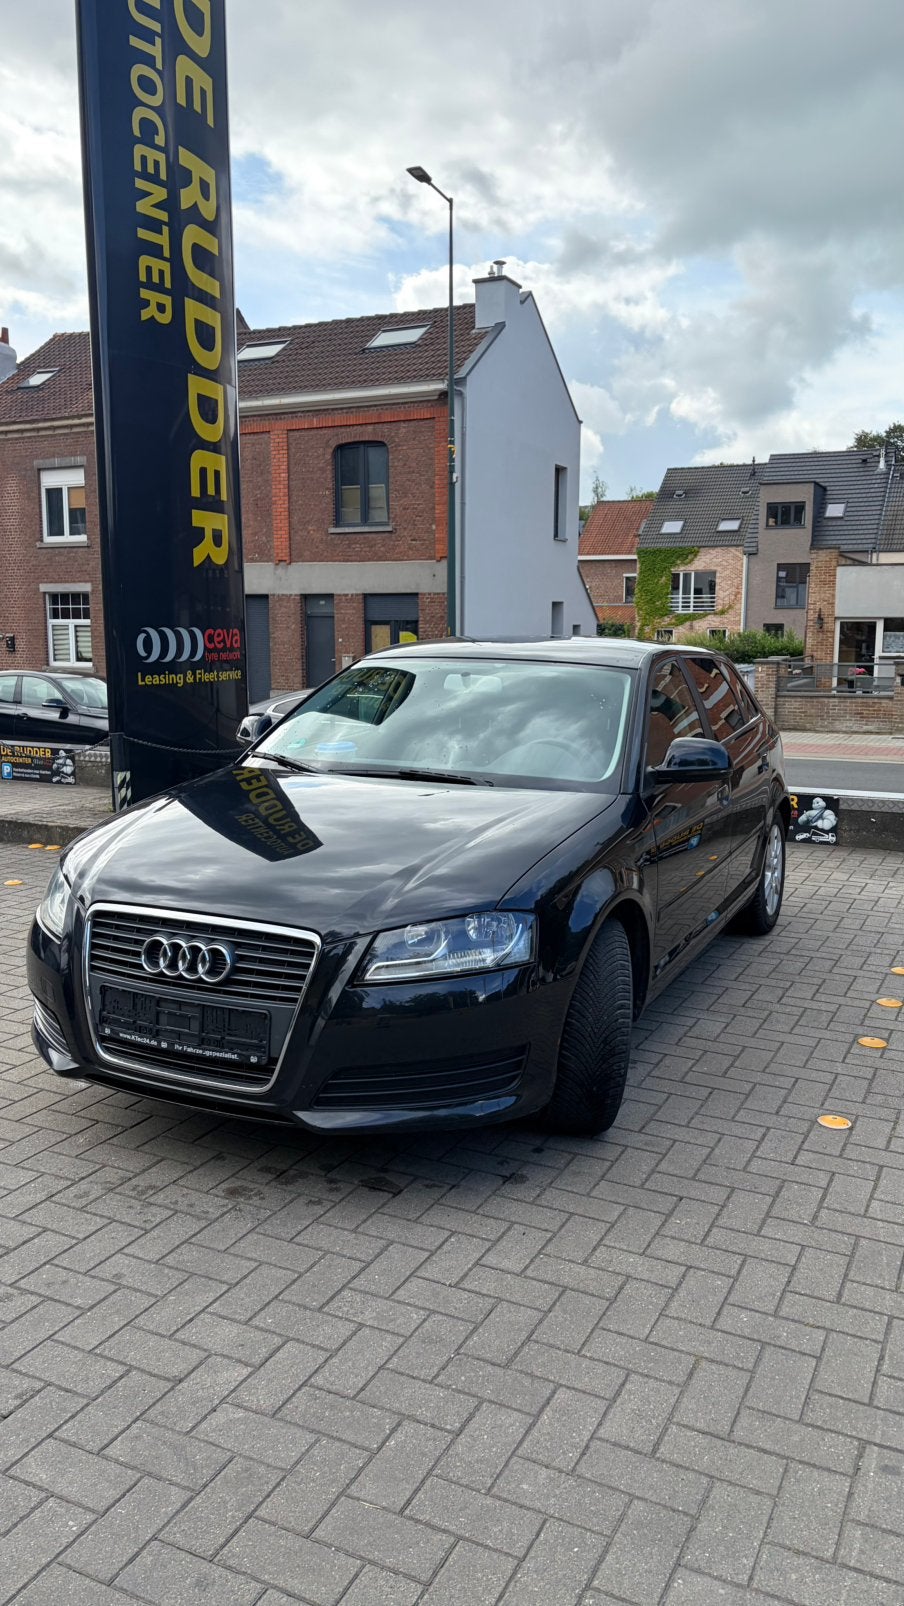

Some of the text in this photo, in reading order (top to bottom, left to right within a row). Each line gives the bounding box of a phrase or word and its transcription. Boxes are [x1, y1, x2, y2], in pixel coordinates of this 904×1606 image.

[174, 0, 229, 568] DE RUDDER
[204, 628, 240, 649] ceva
[205, 650, 240, 663] tyre network
[137, 668, 242, 687] Leasing & Fleet service
[0, 745, 52, 758] DE RUDDER
